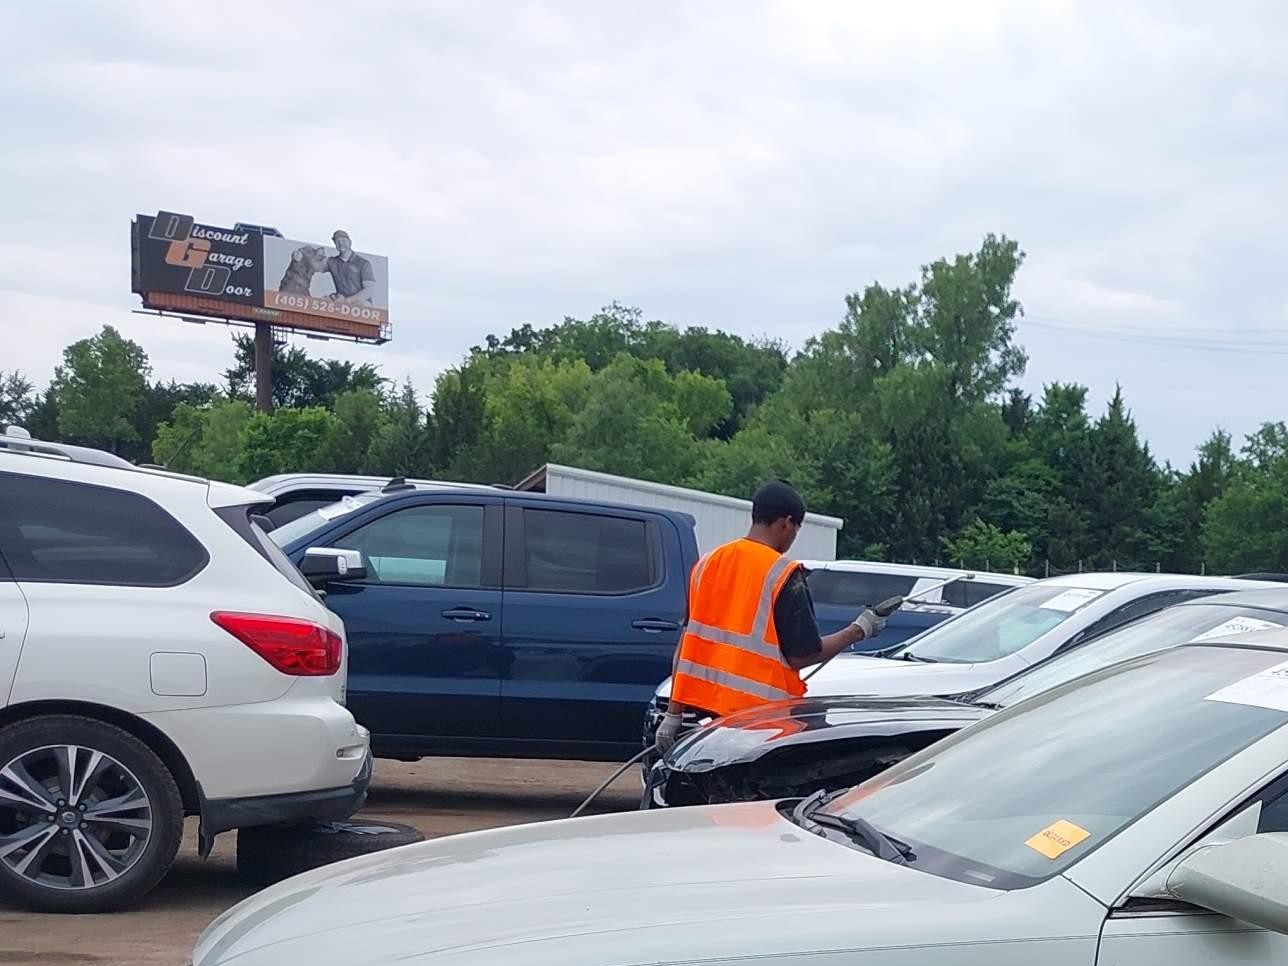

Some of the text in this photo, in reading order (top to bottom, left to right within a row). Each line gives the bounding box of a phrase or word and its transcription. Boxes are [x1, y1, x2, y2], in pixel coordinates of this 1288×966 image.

[148, 210, 249, 245] Discount
[165, 237, 253, 271] Garage
[184, 264, 253, 296] Door
[275, 293, 380, 321] (405) 525-DOOR
